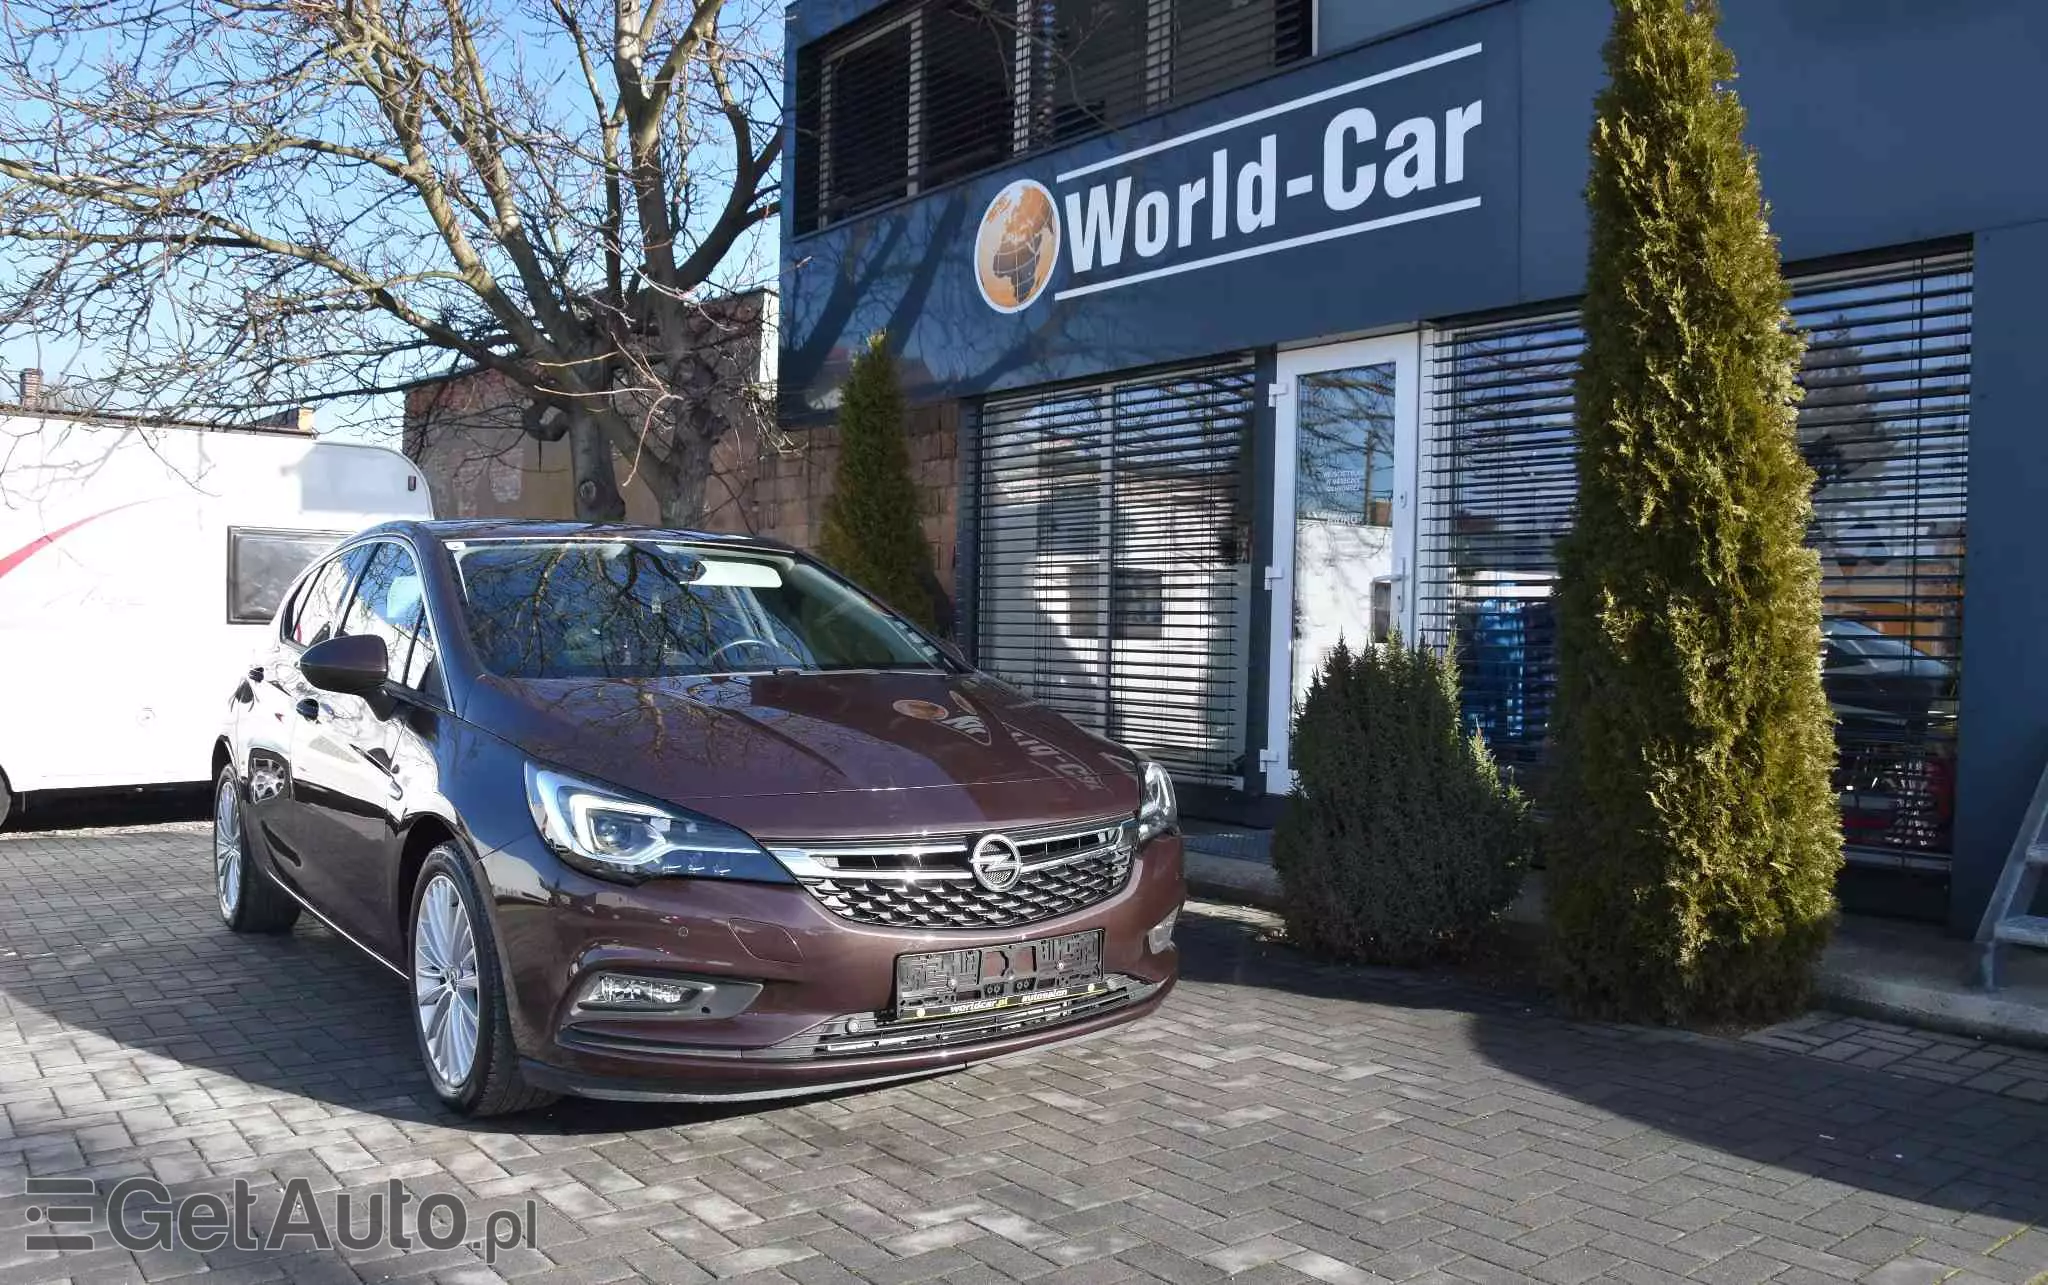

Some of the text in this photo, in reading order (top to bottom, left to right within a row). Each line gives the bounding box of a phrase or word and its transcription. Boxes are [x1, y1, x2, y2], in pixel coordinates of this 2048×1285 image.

[1065, 99, 1482, 274] World-Car
[949, 989, 1068, 1013] worldcar.pl autosalon
